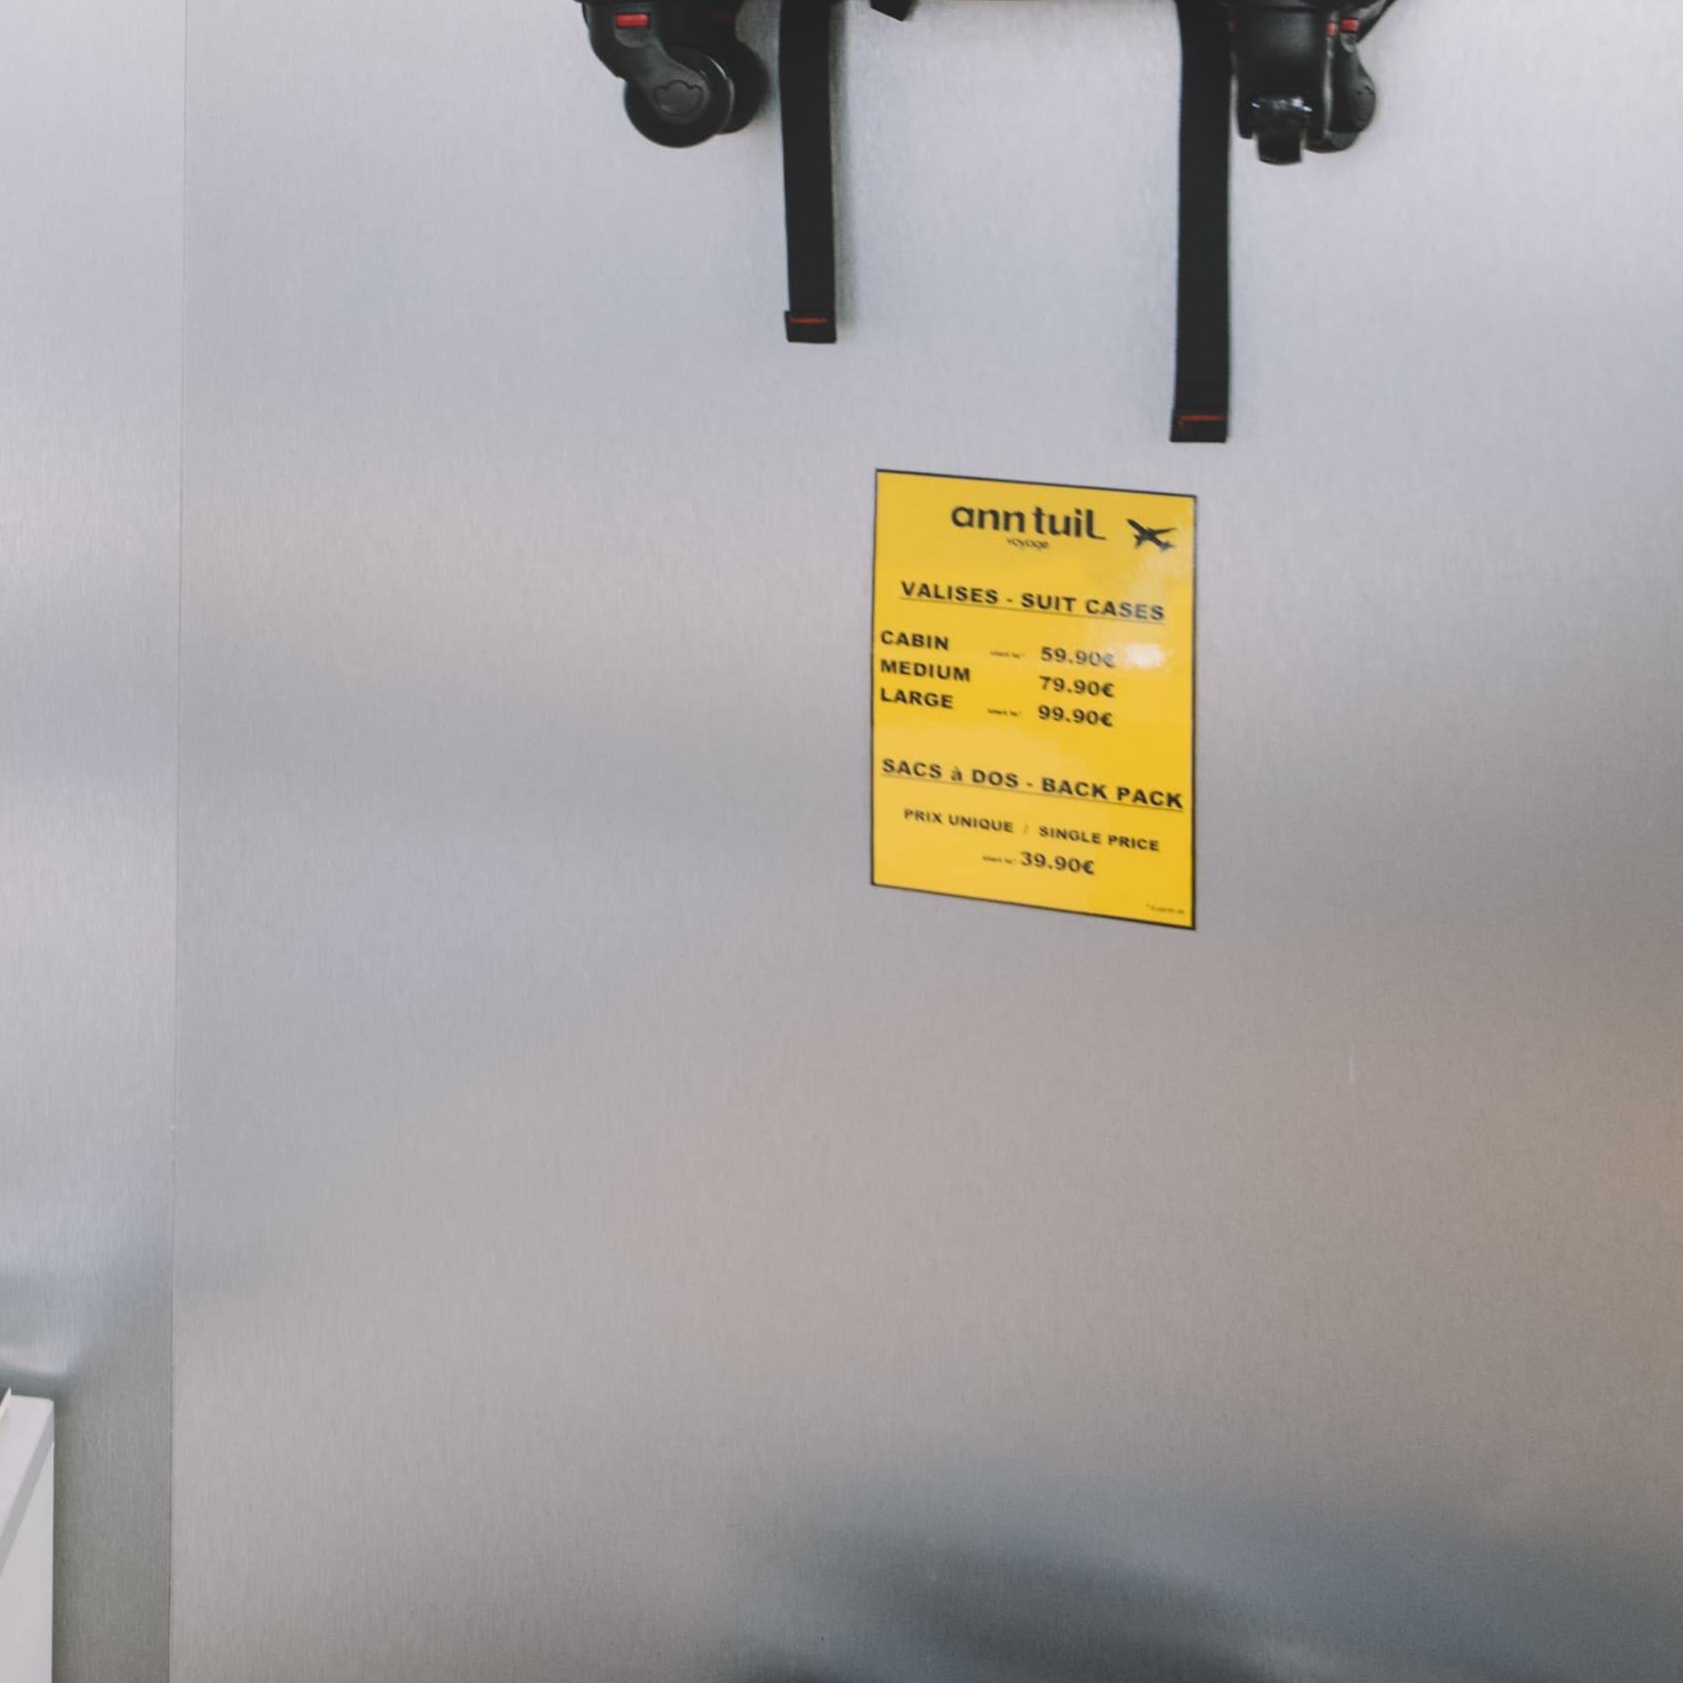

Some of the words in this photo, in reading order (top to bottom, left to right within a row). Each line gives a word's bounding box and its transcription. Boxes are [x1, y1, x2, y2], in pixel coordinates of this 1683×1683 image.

[951, 505, 1025, 533] ann
[1033, 506, 1107, 540] tuil
[900, 581, 999, 605] VALISES
[1021, 593, 1077, 613] SUIT
[1085, 599, 1165, 621] CASES
[879, 630, 950, 651] CABIN
[1040, 646, 1116, 669] 59.90€
[879, 659, 971, 683] MEDIUM
[1038, 675, 1115, 699] 79.90€
[879, 687, 954, 710] LARGE
[1037, 704, 1114, 728] 99.90€
[882, 758, 943, 780] SACS
[950, 766, 964, 782] à
[971, 769, 1020, 789] DOS
[1041, 778, 1109, 801] BACK
[1117, 786, 1185, 810] PACK
[903, 808, 944, 825] PRIX
[947, 814, 1014, 834] UNIQUE
[1038, 826, 1102, 846] SINGLE
[1107, 834, 1160, 853] PRICE
[1020, 851, 1096, 876] 39.90€
